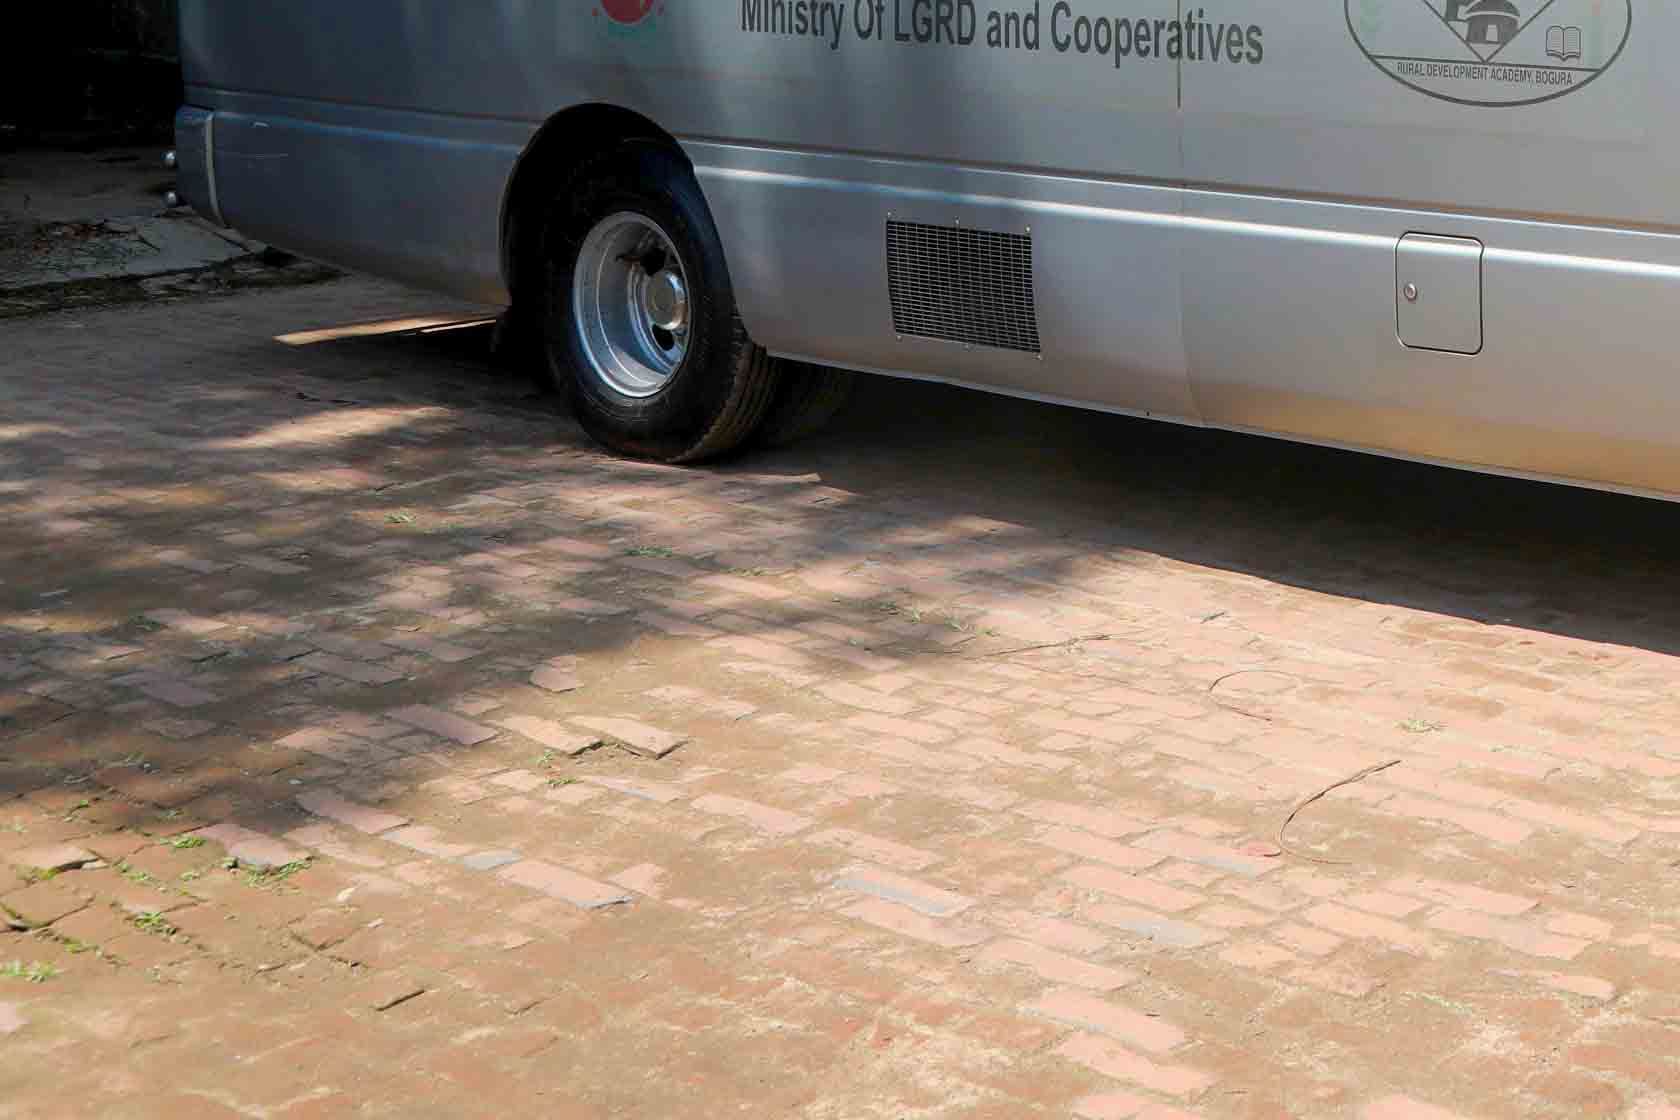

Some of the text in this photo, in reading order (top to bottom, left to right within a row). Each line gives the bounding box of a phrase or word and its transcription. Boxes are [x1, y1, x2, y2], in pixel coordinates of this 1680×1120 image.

[986, 0, 1040, 50] and
[1051, 0, 1264, 69] Cooperatives
[1397, 62, 1425, 76] RURAL
[1426, 63, 1489, 80] DEVELOPMENT
[1536, 70, 1573, 86] BOGURA
